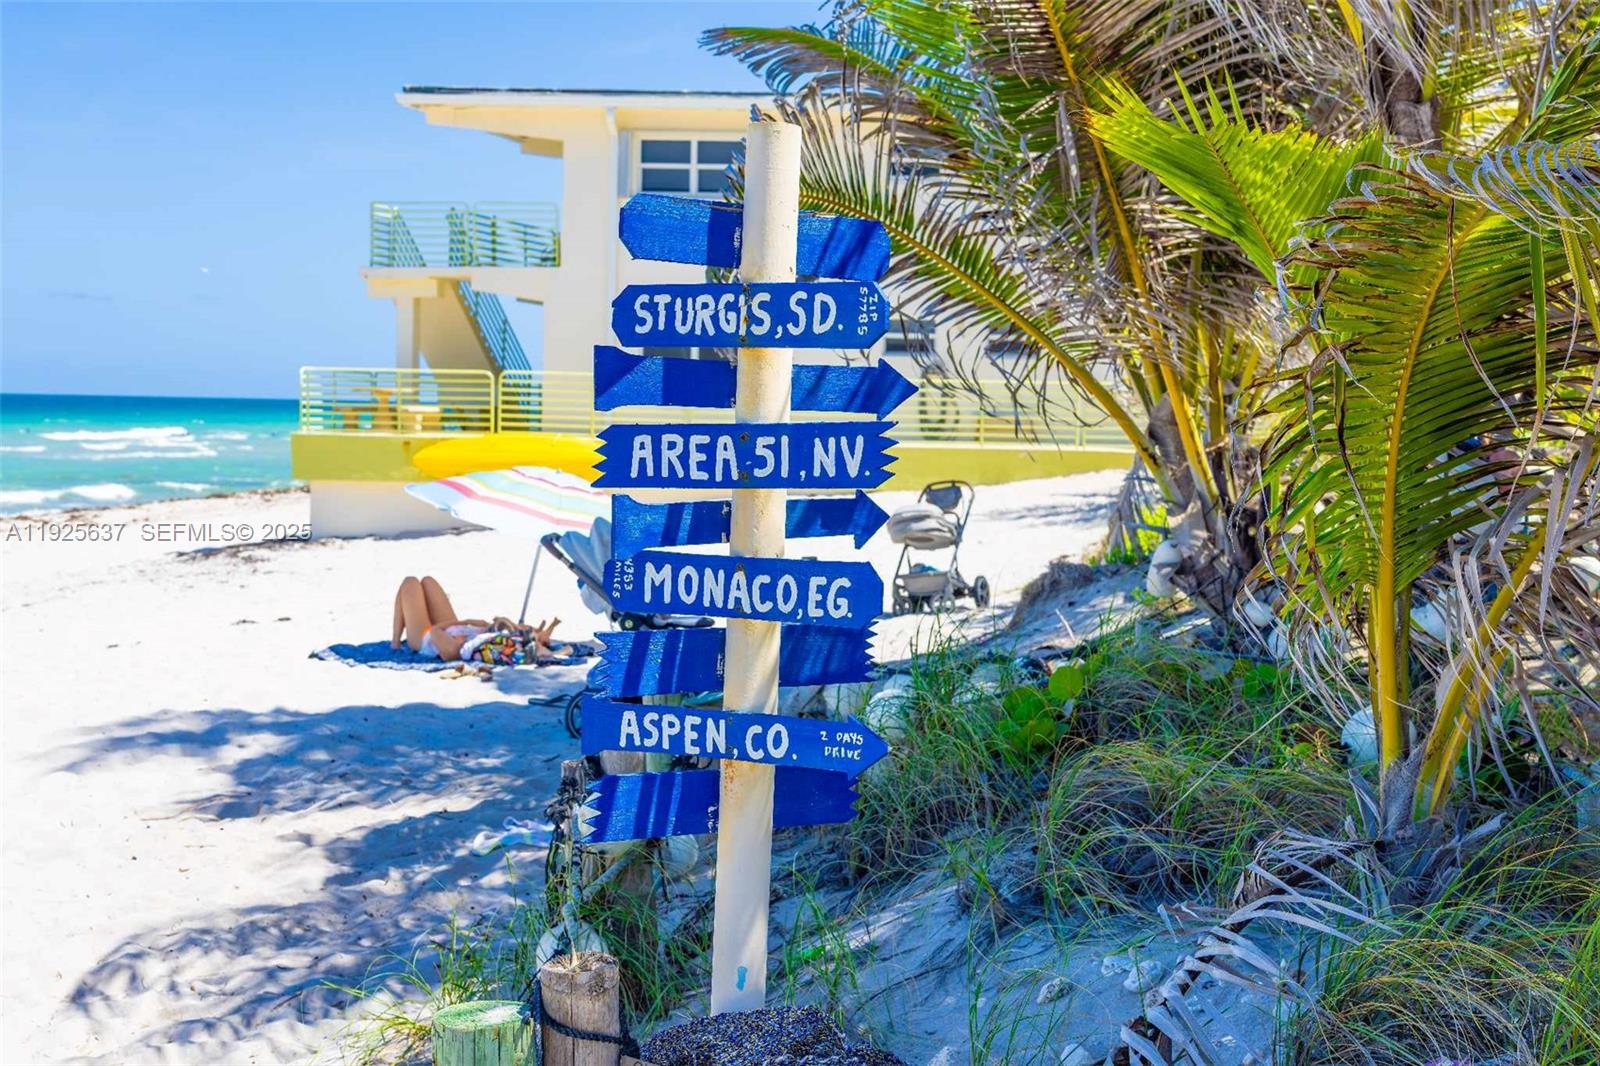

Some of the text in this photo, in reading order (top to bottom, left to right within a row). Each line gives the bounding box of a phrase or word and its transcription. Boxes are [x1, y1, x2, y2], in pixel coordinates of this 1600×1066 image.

[786, 290, 844, 336] SD.
[857, 286, 869, 336] 57785
[869, 293, 878, 321] ZIP
[630, 433, 738, 482] AREA
[813, 434, 871, 479] NV.
[612, 561, 622, 598] MILES
[644, 561, 853, 620] MONACO, EG.
[619, 710, 798, 761] ASPEN, CO.
[820, 730, 864, 746] 2 DAYS
[824, 746, 862, 760] DRIVE
